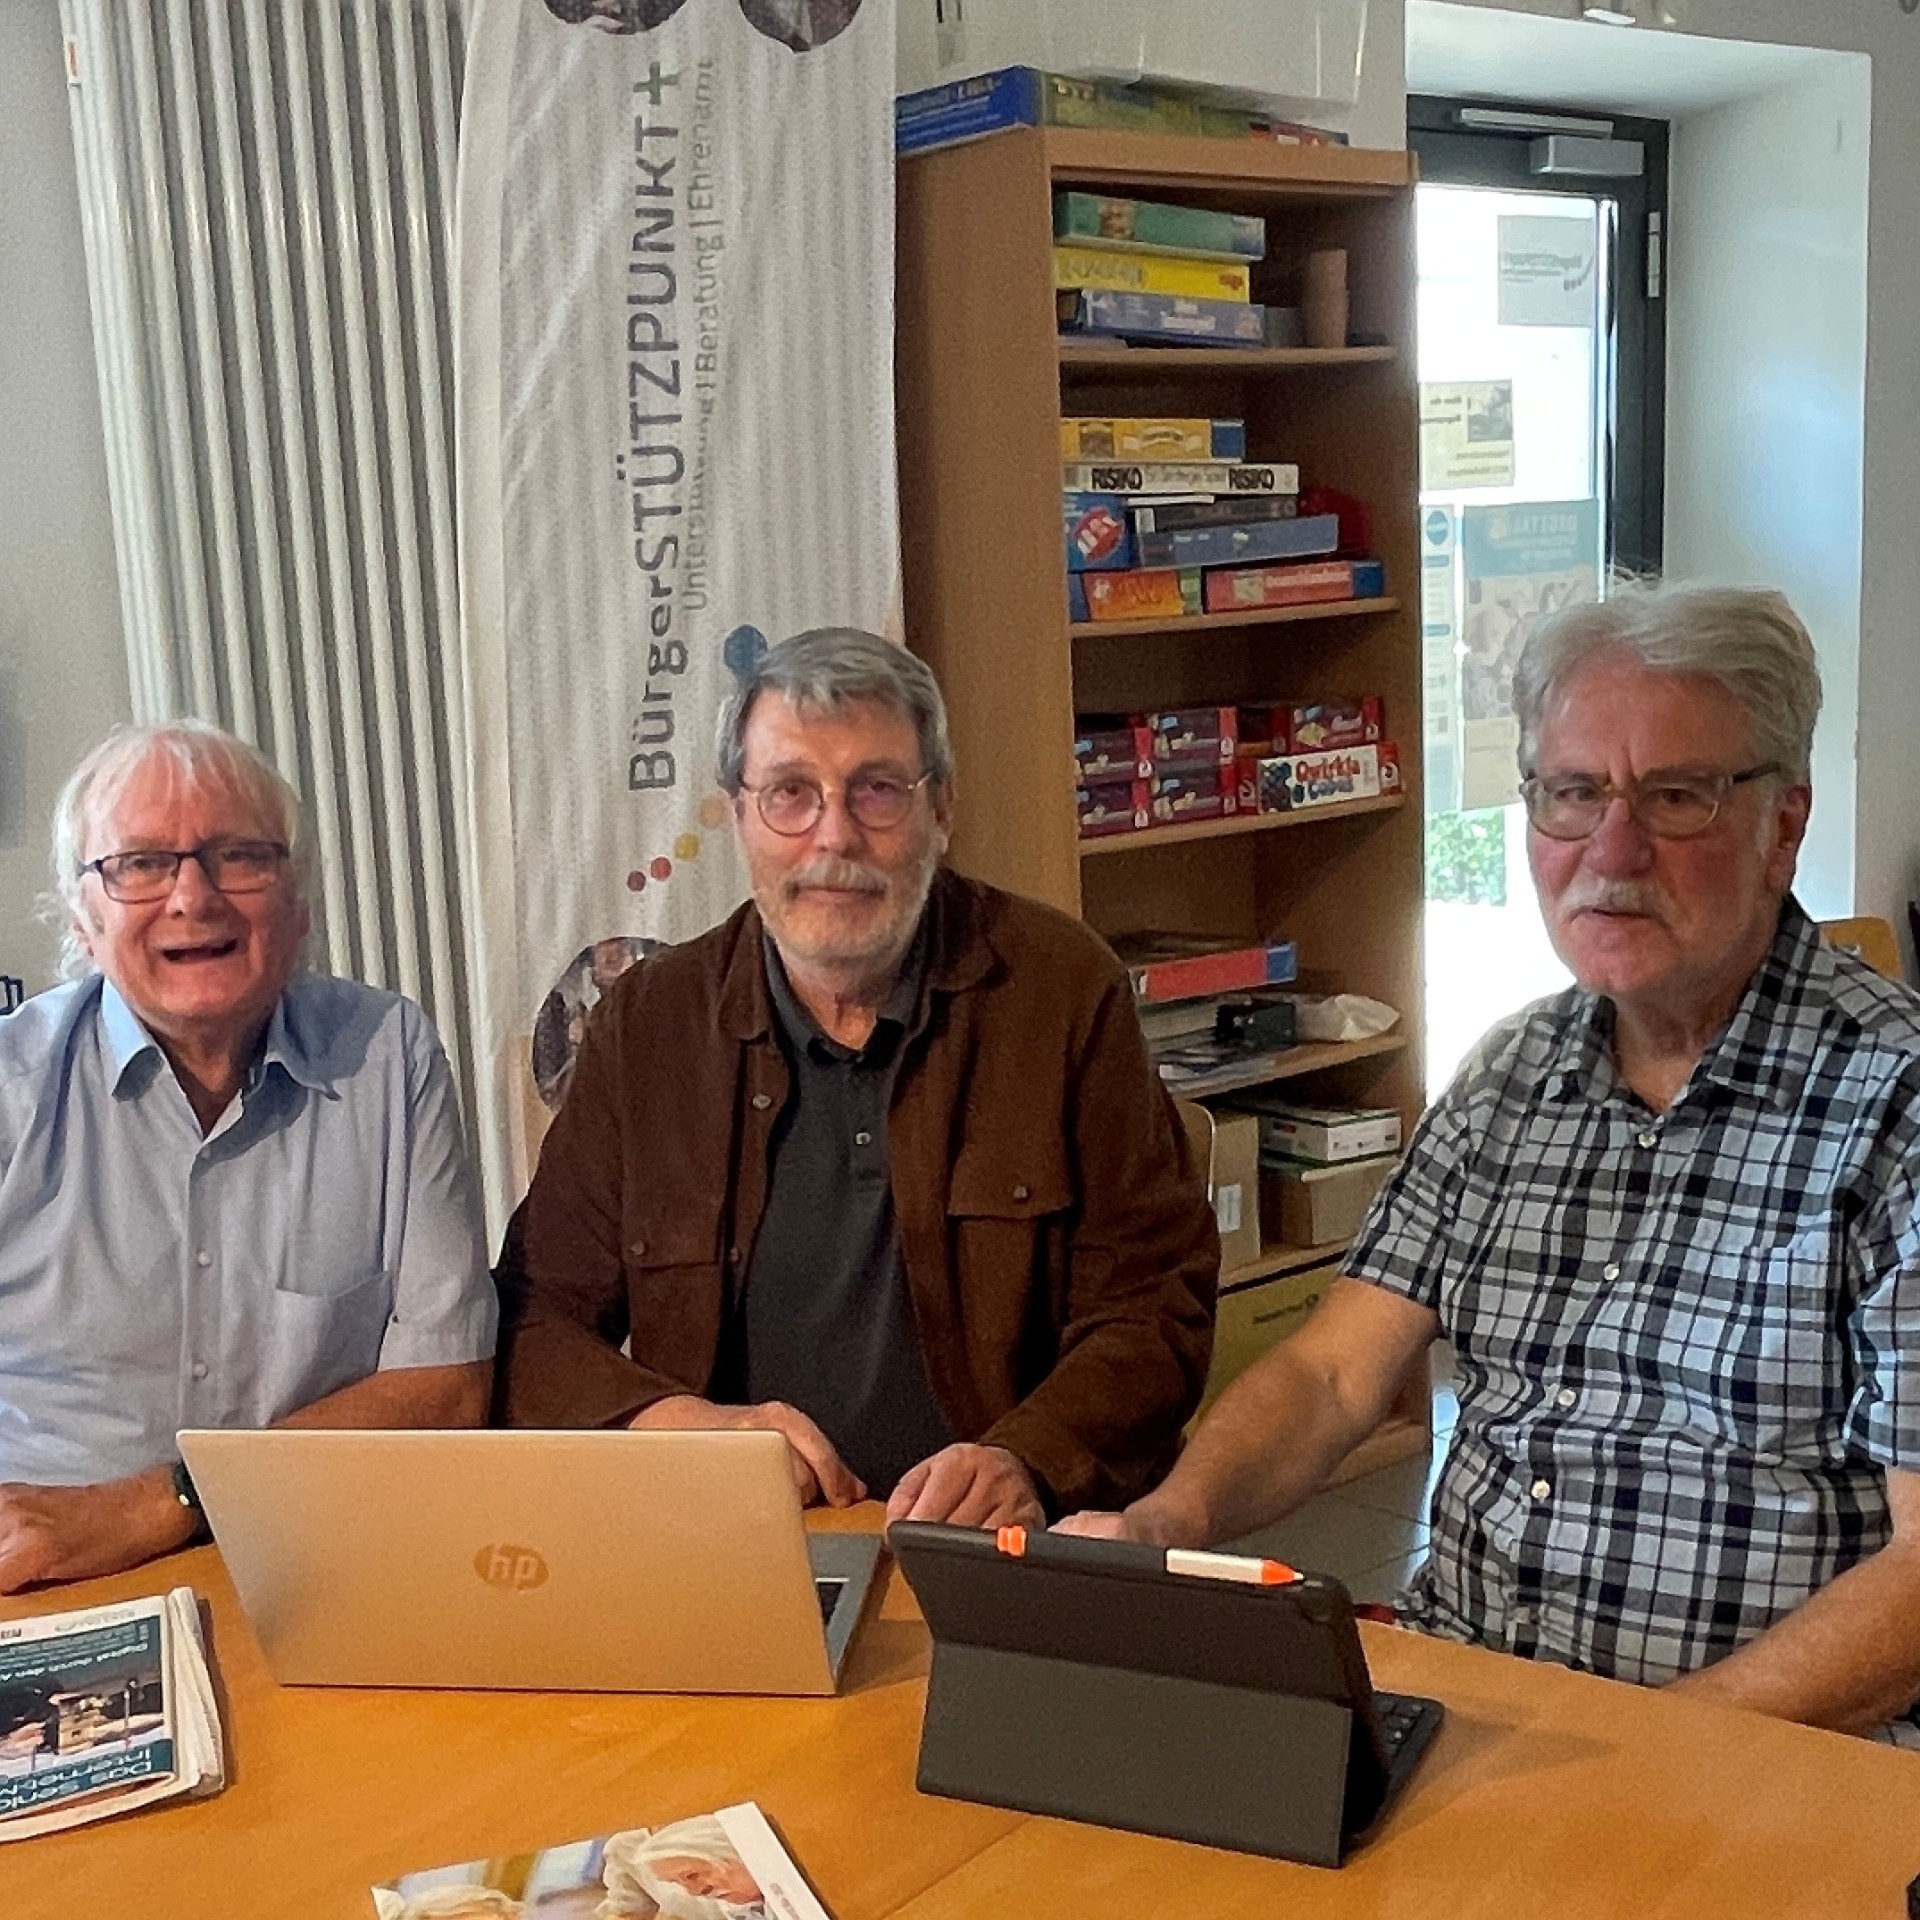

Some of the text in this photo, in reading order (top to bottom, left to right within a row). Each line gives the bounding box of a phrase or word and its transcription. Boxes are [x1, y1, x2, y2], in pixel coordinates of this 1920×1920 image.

[686, 60, 715, 211] Ehrenamt
[694, 234, 725, 372] Beratung
[1092, 467, 1143, 490] RISIKO
[488, 1543, 540, 1594] hp
[90, 1760, 151, 1784] Das
